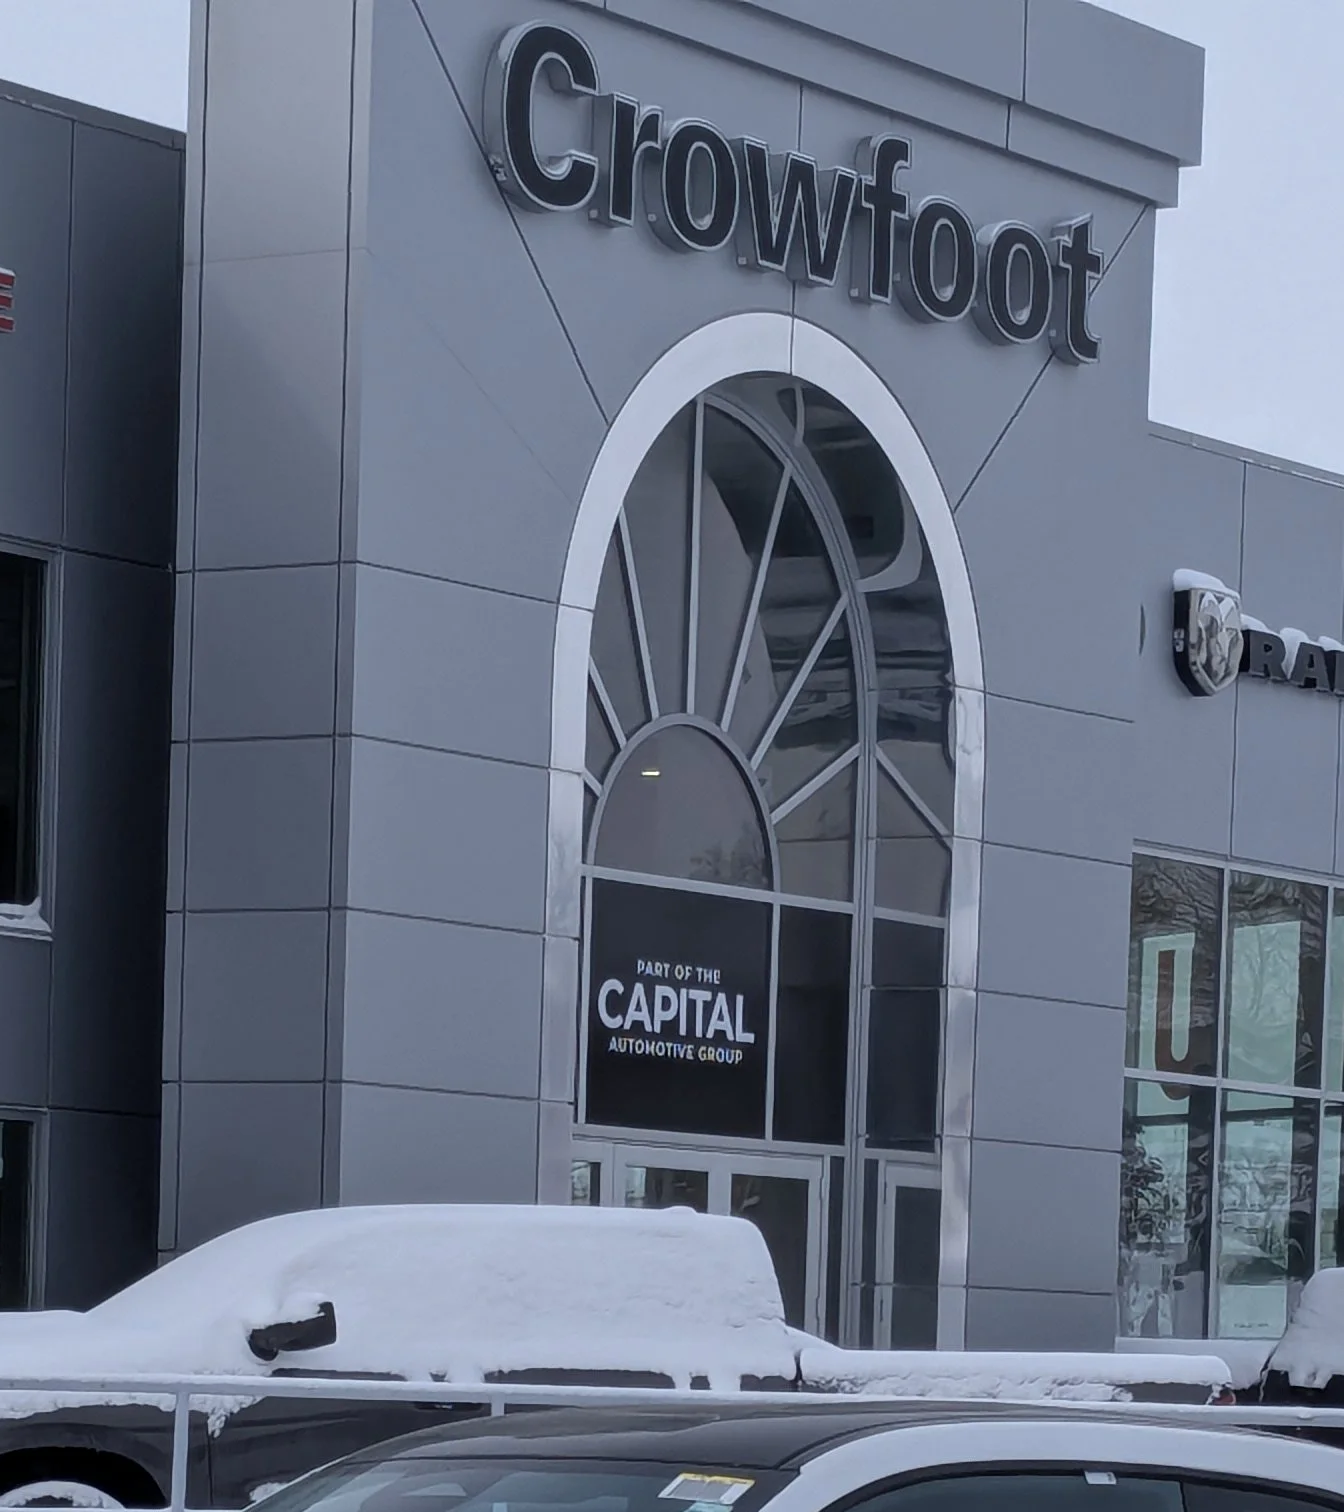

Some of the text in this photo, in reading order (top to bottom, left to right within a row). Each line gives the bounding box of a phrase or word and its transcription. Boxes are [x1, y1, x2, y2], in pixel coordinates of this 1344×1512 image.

[496, 22, 1105, 365] Crowfoot
[636, 959, 721, 985] PART OF THE
[597, 978, 755, 1044] CAPITAL
[608, 1036, 743, 1064] AUTOMOTIVE GROUP
